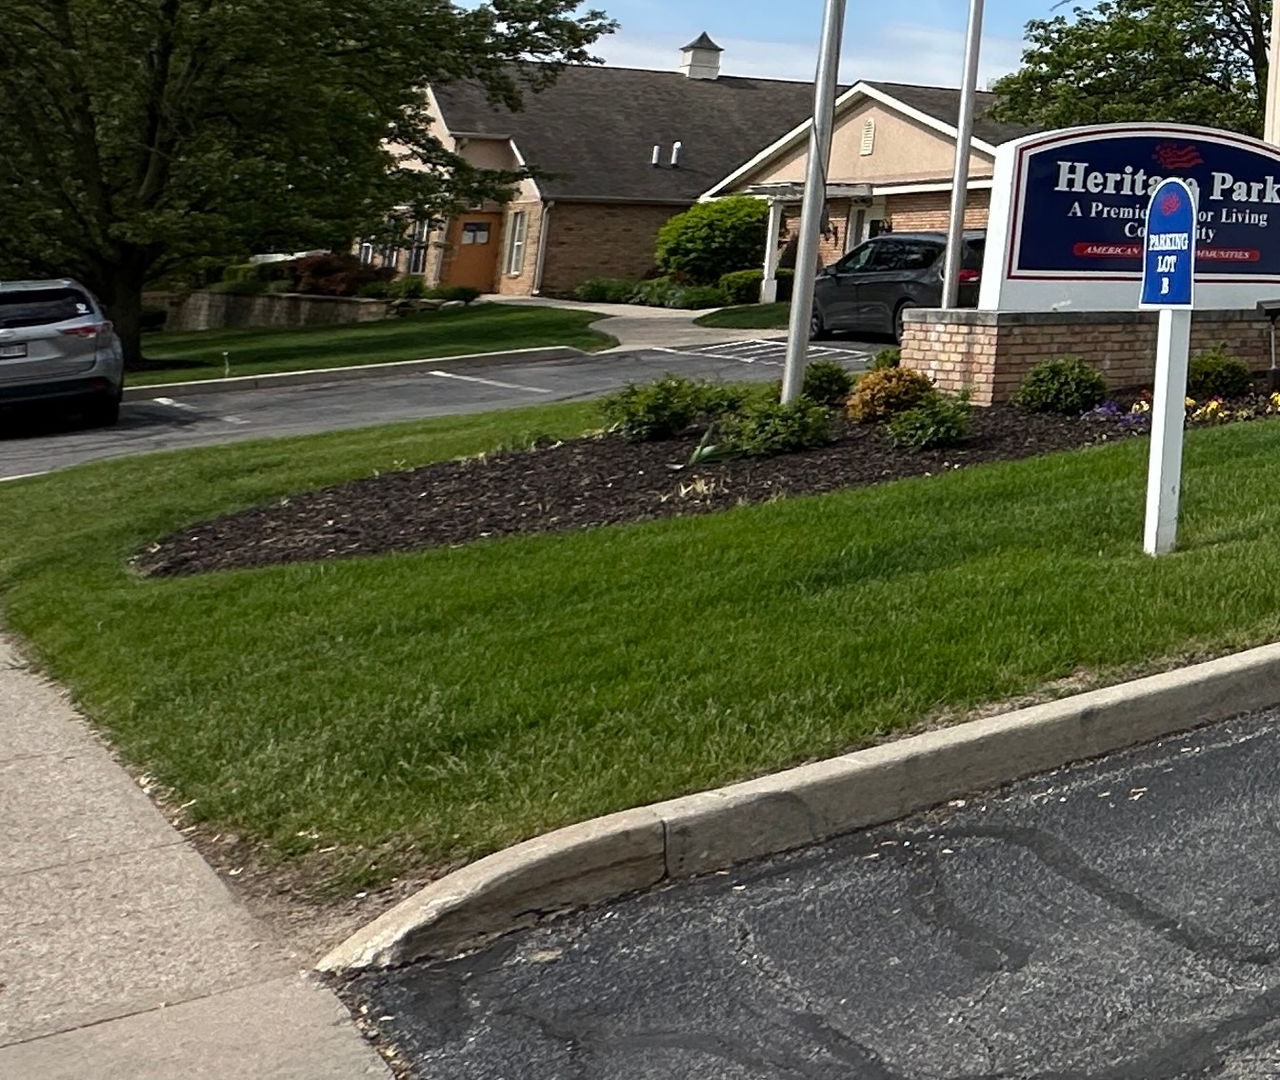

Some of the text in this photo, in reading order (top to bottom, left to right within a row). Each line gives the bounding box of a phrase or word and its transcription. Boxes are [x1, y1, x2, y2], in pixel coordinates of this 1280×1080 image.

[1209, 171, 1280, 204] Park
[1067, 201, 1083, 217] A
[1220, 208, 1268, 227] Living
[1124, 221, 1215, 243] Coity
[1148, 232, 1188, 251] PARKING
[1083, 245, 1139, 255] AMERICAN
[1156, 255, 1177, 273] LOT
[1160, 277, 1169, 295] B
